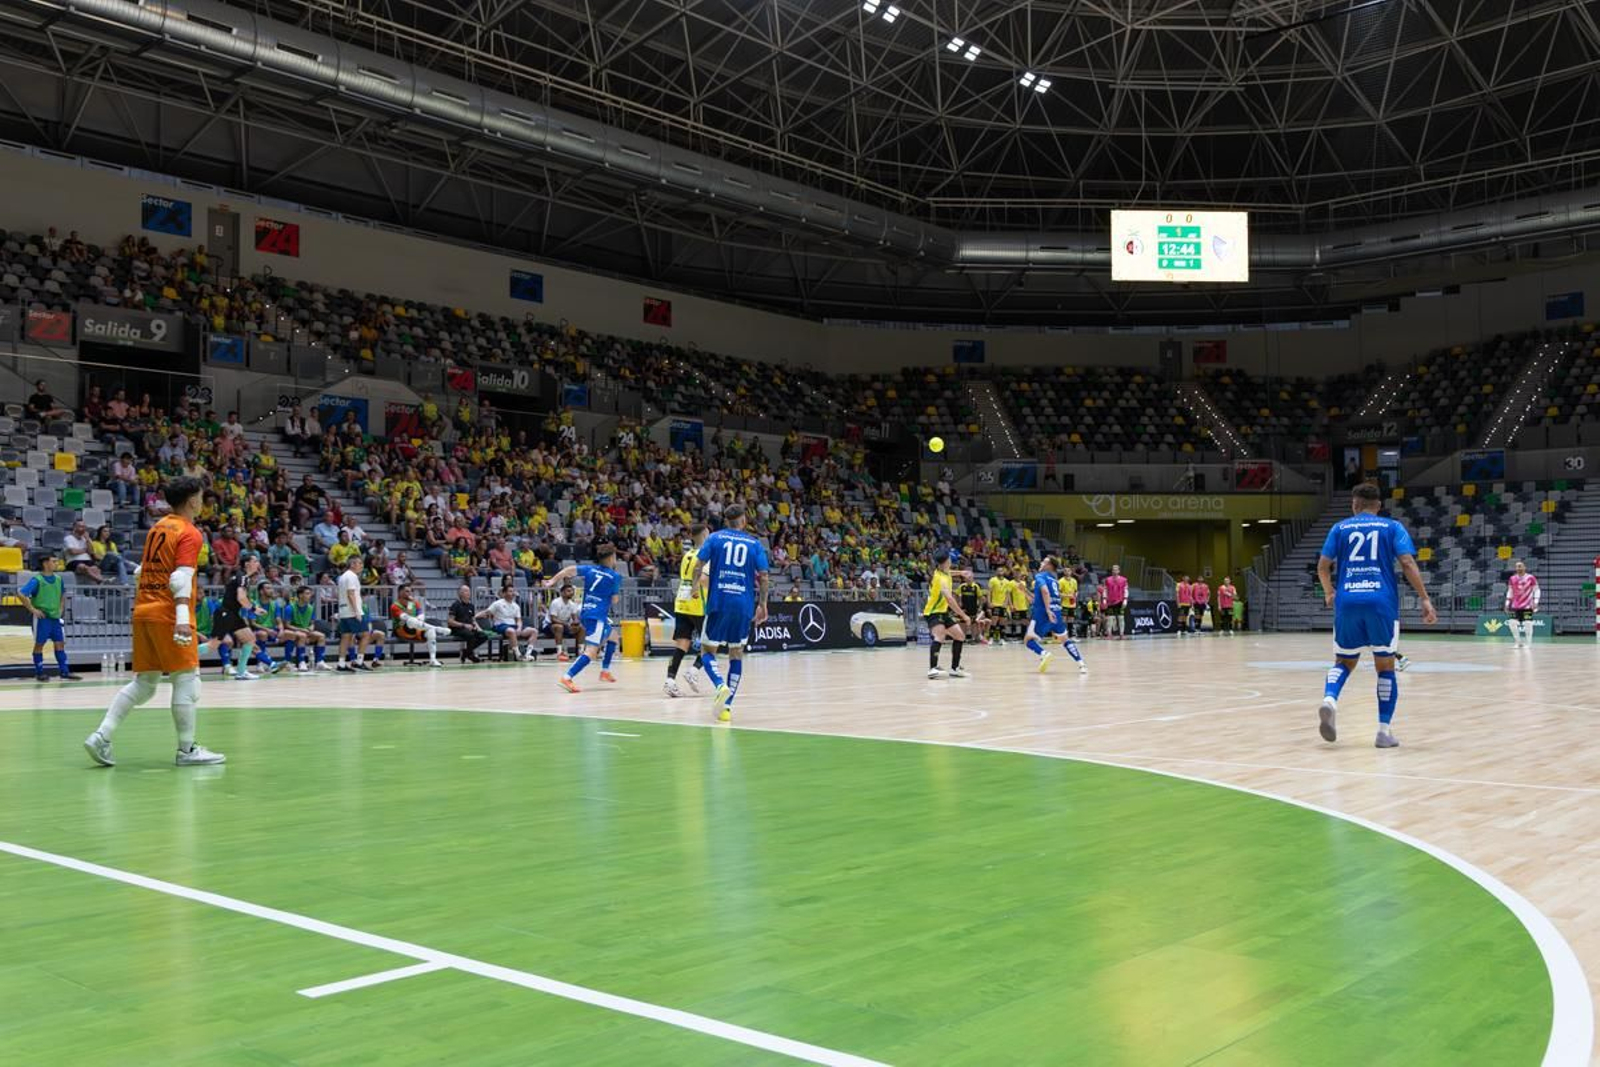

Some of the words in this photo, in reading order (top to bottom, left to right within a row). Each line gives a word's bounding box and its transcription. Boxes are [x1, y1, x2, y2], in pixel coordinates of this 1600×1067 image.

[140, 192, 175, 210] Sector
[1166, 213, 1173, 224] 0
[1186, 213, 1193, 224] 0
[1162, 243, 1195, 256] 12:44
[84, 318, 141, 339] Salida
[150, 319, 167, 342] 9
[512, 370, 529, 389] 10
[319, 394, 351, 407] Sector
[559, 425, 576, 440] 24
[618, 431, 634, 445] 24
[1382, 422, 1398, 438] 12
[1565, 456, 1585, 470] 30
[1119, 494, 1163, 511] olivo
[1167, 497, 1225, 511] arena
[1348, 530, 1379, 561] 21
[723, 541, 748, 567] 10
[588, 574, 603, 591] 7
[754, 626, 791, 642] JADISA
